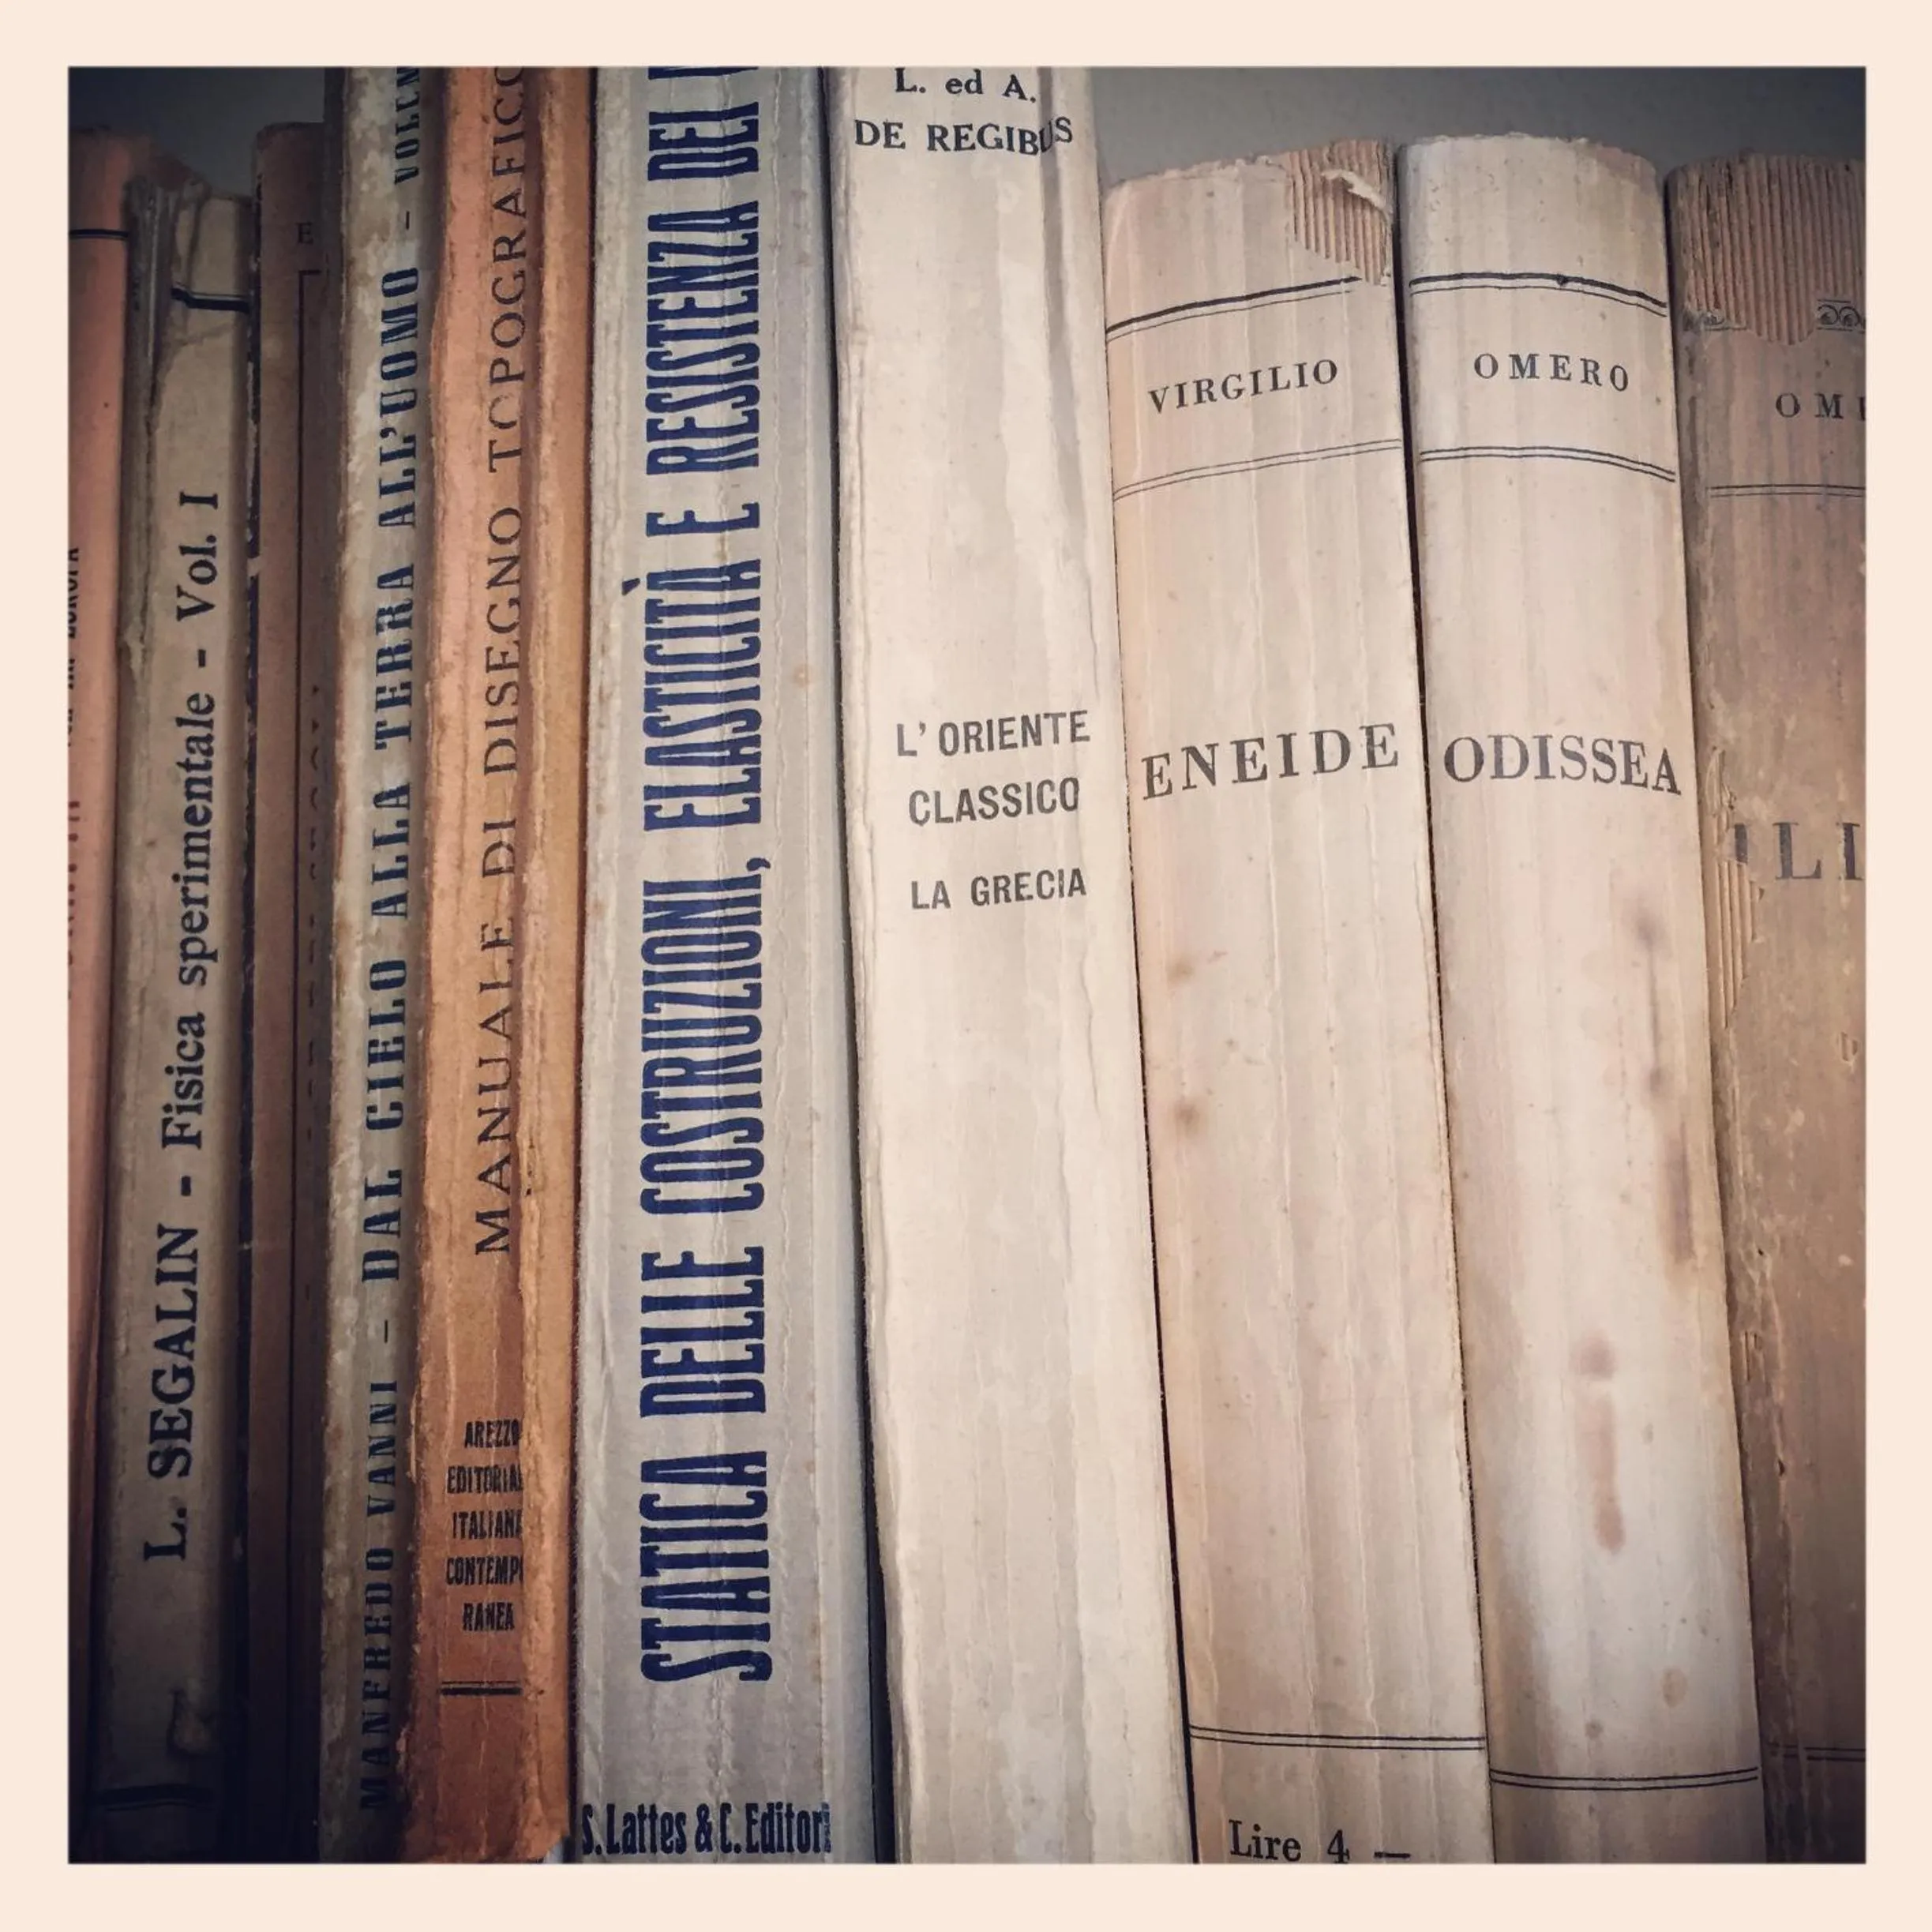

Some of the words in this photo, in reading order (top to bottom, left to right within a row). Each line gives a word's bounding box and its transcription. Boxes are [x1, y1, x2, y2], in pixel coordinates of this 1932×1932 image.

[895, 67, 926, 93] L.
[945, 69, 985, 95] ed
[1002, 74, 1037, 103] A.
[647, 101, 760, 182] DEI
[854, 119, 906, 149] DE
[927, 116, 1073, 156] REGIBUS
[644, 199, 760, 475] RESISTENZA
[1473, 353, 1630, 392] OMERO
[378, 267, 419, 529] ALL'UOMO
[1147, 358, 1338, 415] VIRGILIO
[178, 491, 219, 509] I
[645, 501, 760, 538] E
[176, 534, 217, 622] Vol.
[374, 563, 415, 750] TERRA
[484, 507, 523, 776] DISEGNO
[621, 558, 763, 832] ELASTICITÀ
[908, 776, 1081, 827] CLASSICO
[1141, 722, 1399, 801] ENEIDE
[1443, 733, 1683, 796] ODISSEA
[172, 692, 218, 986] sperimentale
[371, 782, 411, 919] ALLA
[482, 818, 517, 880] DI
[911, 880, 951, 910] LA
[970, 868, 1087, 907] GRECIA
[366, 959, 407, 1131] CIELO
[639, 857, 771, 1215] COSTRUZIONI,
[161, 1012, 205, 1150] Fisica
[475, 917, 516, 1256] MANUALE
[362, 1169, 403, 1283] DAL
[148, 1223, 198, 1478] SEGALIN
[639, 1245, 766, 1418] DELLE
[366, 1380, 398, 1518] VANNI
[463, 1419, 520, 1449] AREZZO
[143, 1506, 187, 1562] L.
[639, 1450, 773, 1682] STATICA
[463, 1601, 515, 1632] RANEA
[360, 1547, 394, 1811] MANFREDO
[694, 1802, 714, 1854] &
[1229, 1818, 1303, 1863] Lire
[1326, 1829, 1351, 1864] 4
